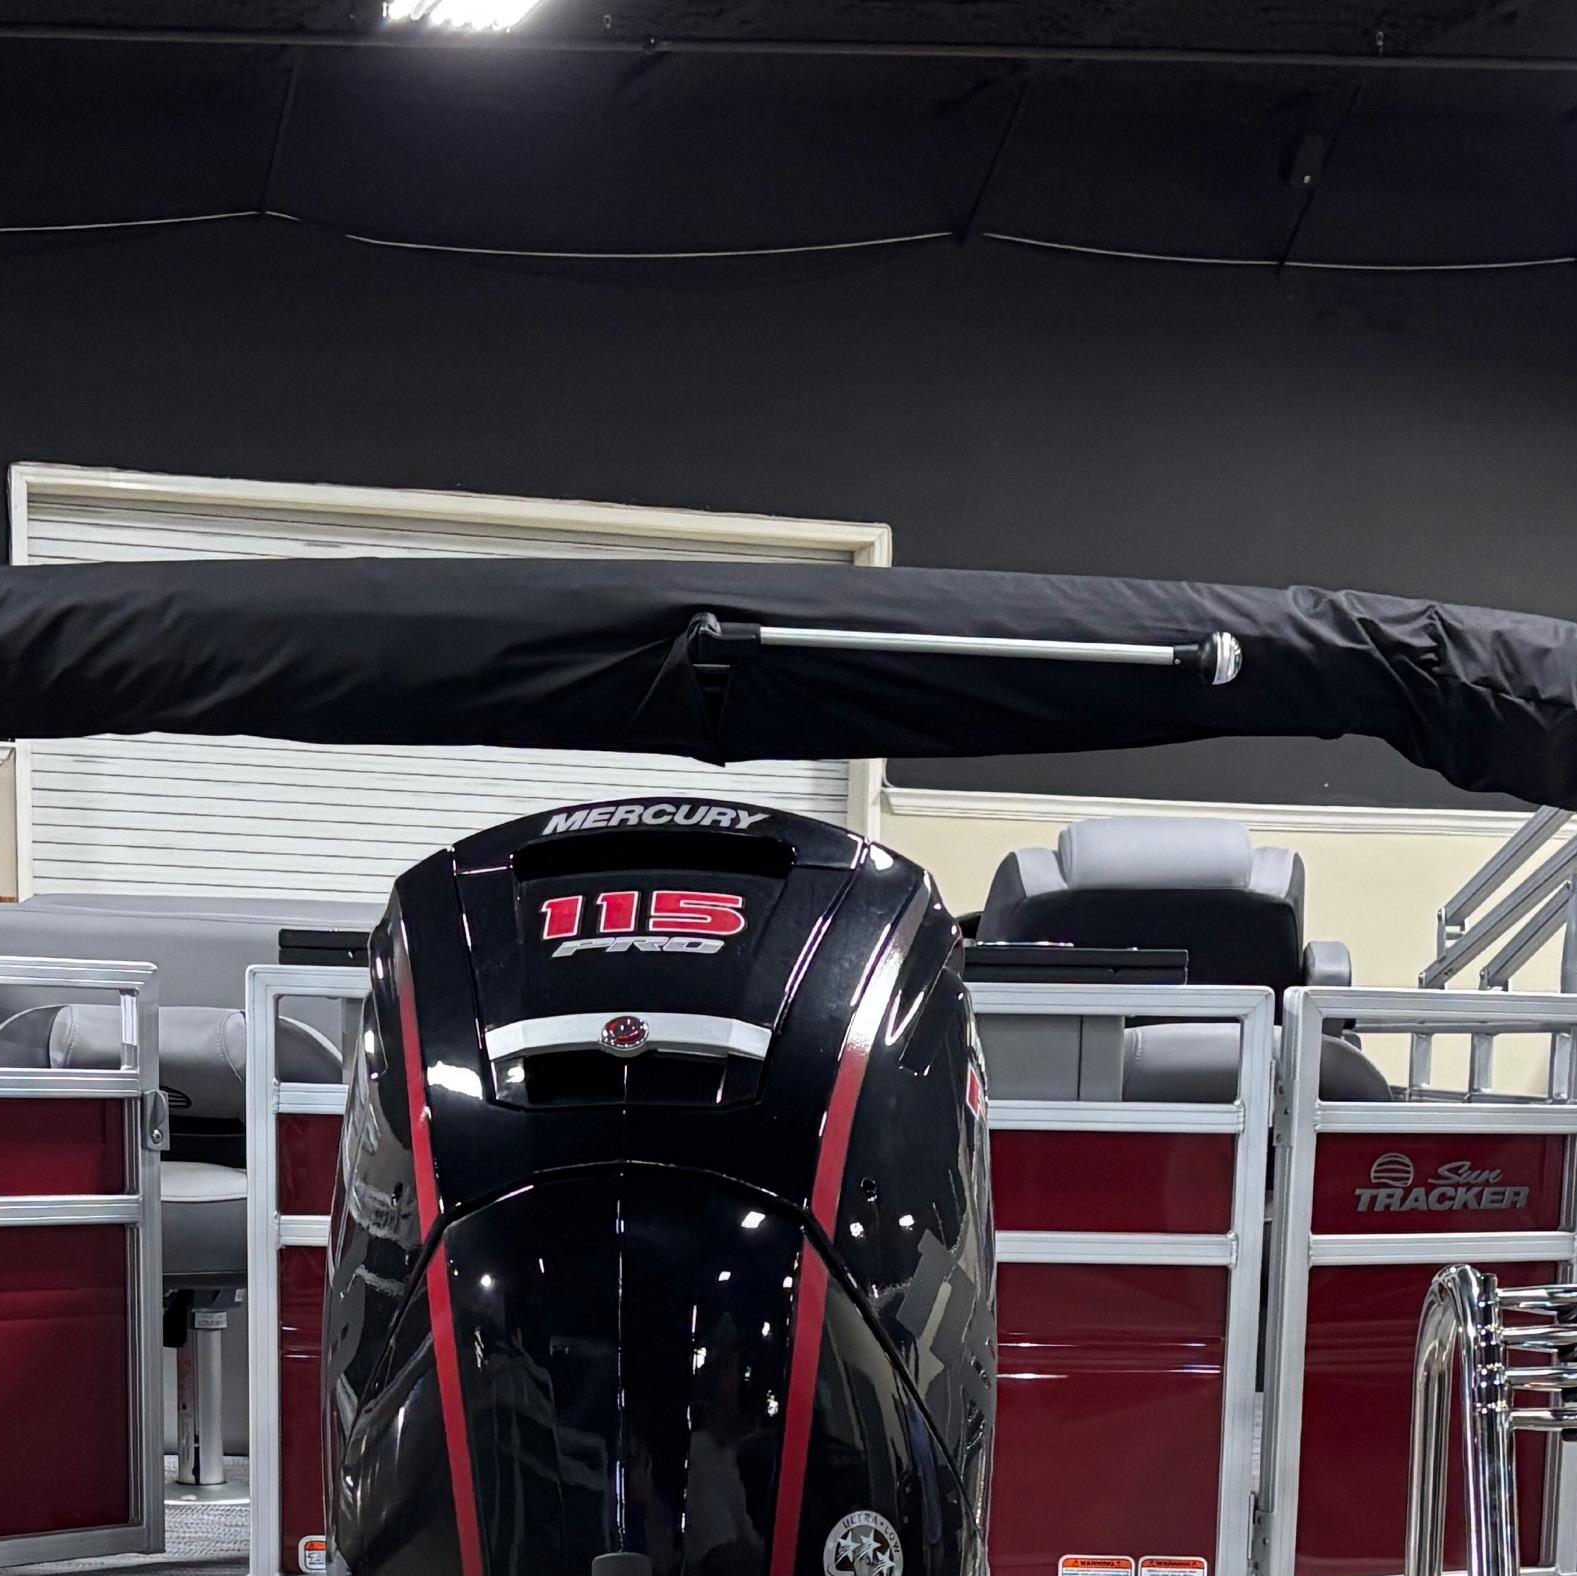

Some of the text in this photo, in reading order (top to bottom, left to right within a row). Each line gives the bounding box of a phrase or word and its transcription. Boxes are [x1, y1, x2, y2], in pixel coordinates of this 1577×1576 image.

[541, 803, 770, 835] MERCURY
[540, 890, 746, 940] 115
[551, 936, 725, 958] PRO
[1427, 1160, 1503, 1186] Sun
[1354, 1186, 1530, 1212] TRACKER
[842, 1512, 879, 1529] ULTRA
